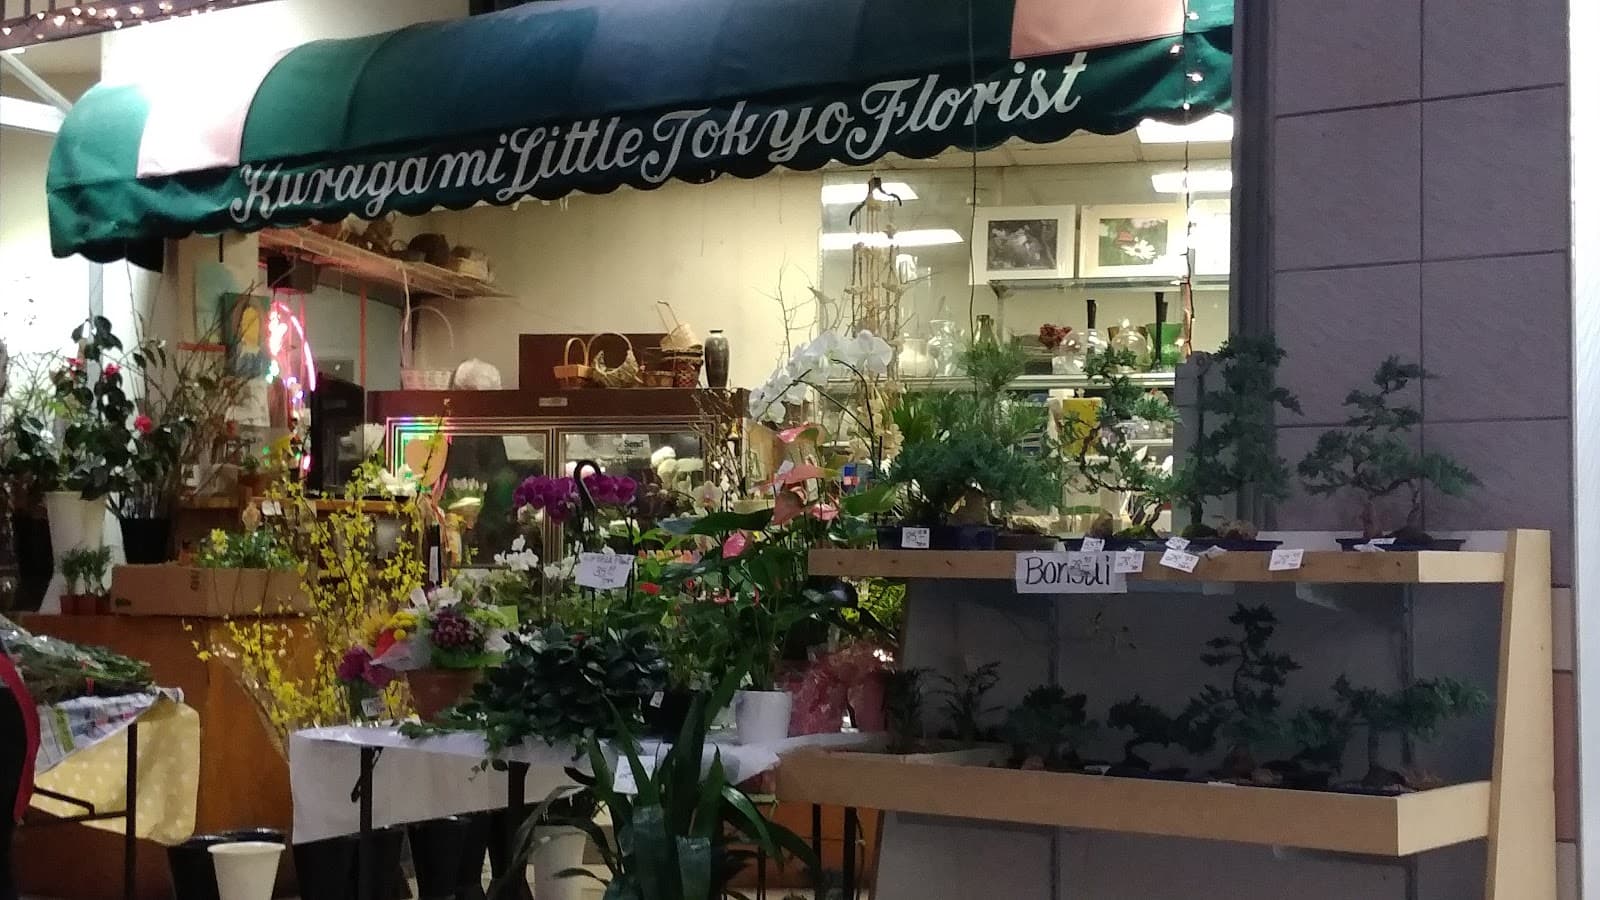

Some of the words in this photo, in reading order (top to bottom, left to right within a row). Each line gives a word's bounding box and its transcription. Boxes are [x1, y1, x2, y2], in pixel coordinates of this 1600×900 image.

[230, 134, 506, 223] Kuragami
[495, 116, 643, 202] Little
[640, 100, 853, 183] Tokyo
[844, 51, 1087, 161] Florist
